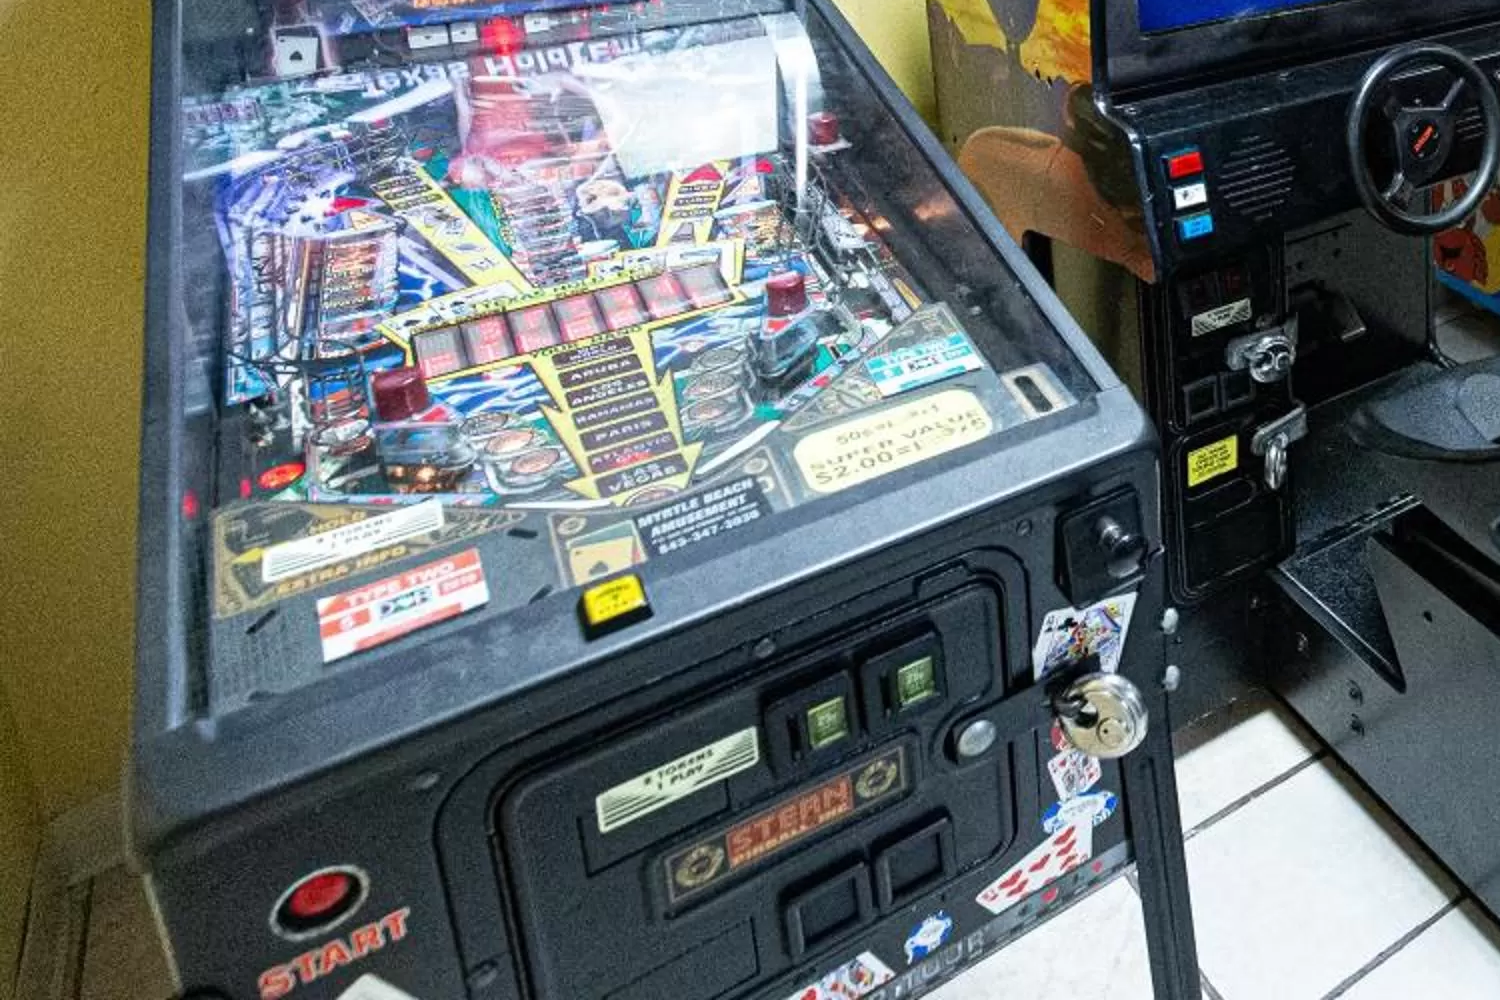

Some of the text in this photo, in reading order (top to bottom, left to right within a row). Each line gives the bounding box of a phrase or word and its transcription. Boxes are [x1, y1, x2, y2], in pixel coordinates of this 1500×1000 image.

[595, 419, 653, 442] PARIS
[607, 466, 677, 494] VEGAS
[637, 497, 700, 529] MYRTLE
[703, 477, 754, 504] BEACH
[650, 493, 748, 538] AMUSEMENT
[406, 561, 456, 586] TWO
[670, 764, 705, 789] PLAY
[730, 778, 852, 852] STERN
[258, 906, 410, 1000] START
